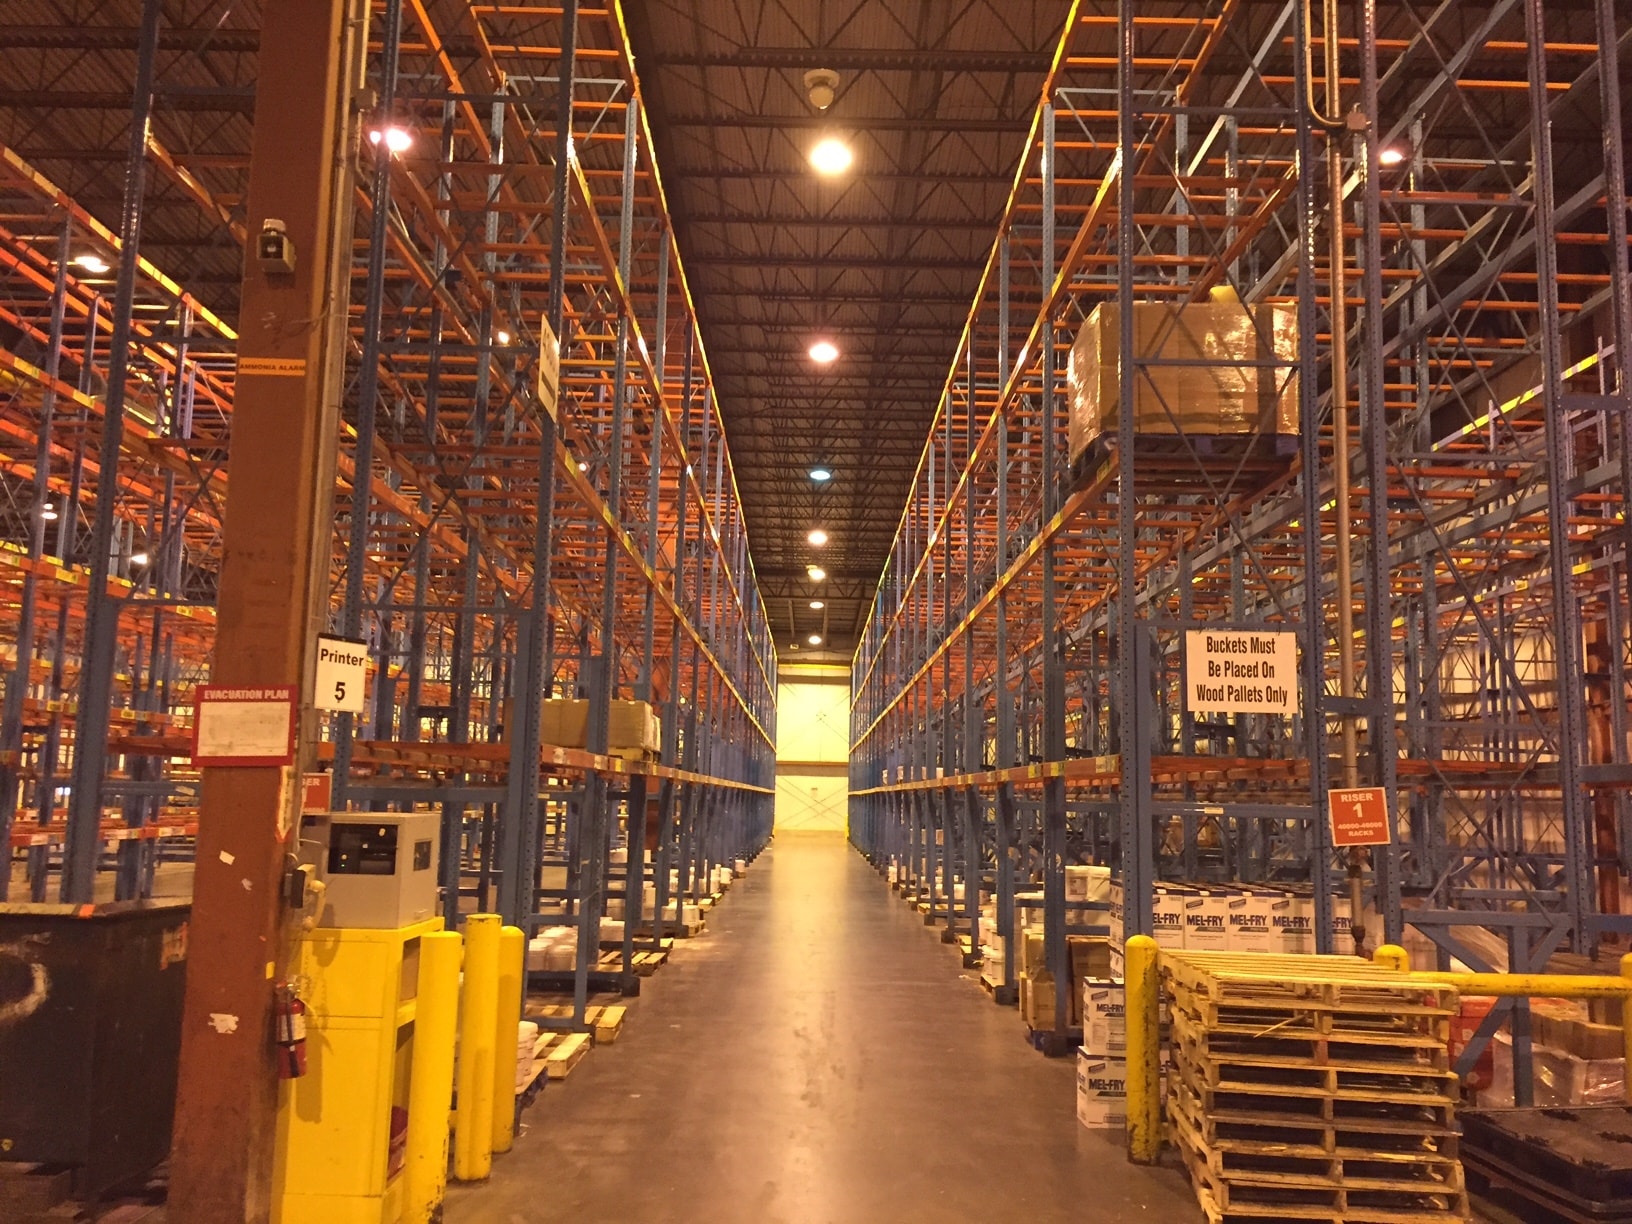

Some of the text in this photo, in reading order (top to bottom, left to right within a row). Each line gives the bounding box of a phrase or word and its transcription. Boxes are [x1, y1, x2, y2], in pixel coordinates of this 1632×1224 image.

[1206, 636, 1275, 654] Buckets Must
[320, 648, 364, 666] Printer
[1208, 660, 1274, 678] Be Placed On
[204, 689, 289, 700] EVACUATION PLAN
[334, 681, 345, 701] 5
[1196, 684, 1288, 706] Wood Pallets Only
[1341, 793, 1373, 802] RISER
[1353, 803, 1363, 818] 1
[1153, 913, 1181, 924] EL-FRY
[1187, 915, 1224, 927] MEL-FRY
[1230, 914, 1267, 926] MEL-FRY
[1273, 916, 1311, 928] MEL-FRY
[1096, 1004, 1125, 1012] MEL-FRY
[1089, 1079, 1125, 1091] MEL-FRY
